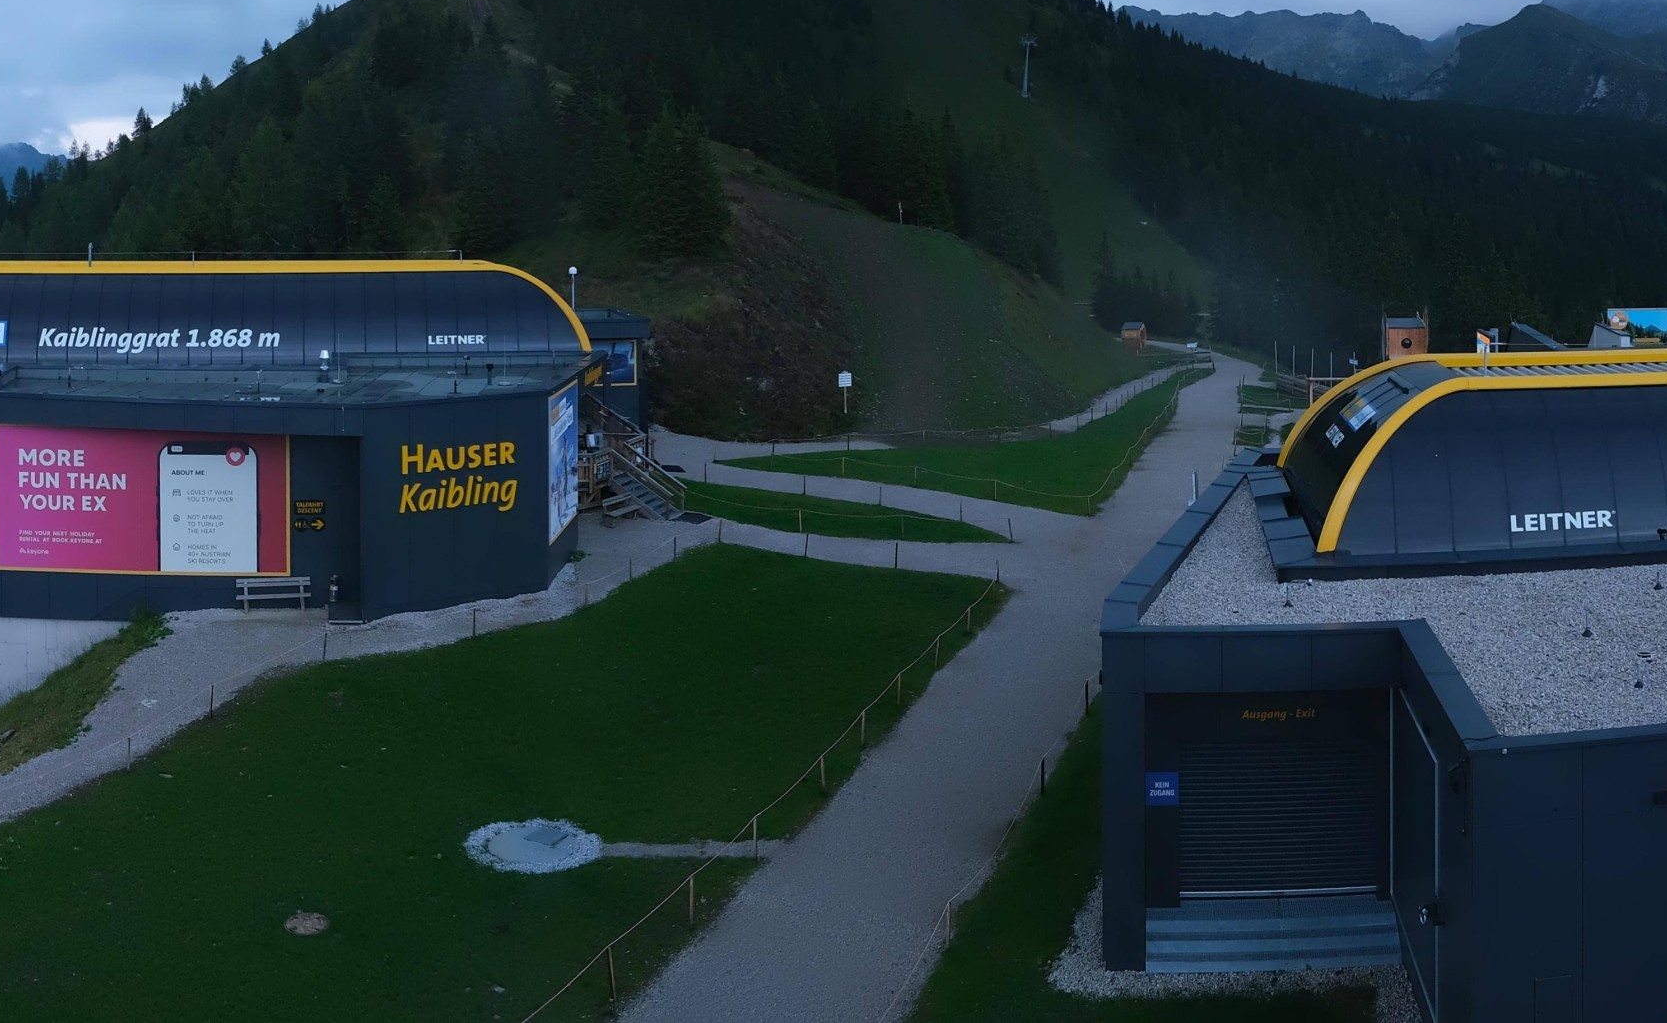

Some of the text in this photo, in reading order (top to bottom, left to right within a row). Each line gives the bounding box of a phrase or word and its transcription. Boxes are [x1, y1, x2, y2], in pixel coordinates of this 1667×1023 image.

[38, 327, 280, 354] Kaiblinggrat 1.868 m
[427, 334, 485, 345] LEITNER
[18, 448, 85, 467] MORE
[401, 441, 516, 475] HAUSER
[18, 471, 127, 490] FUN THAN
[19, 494, 107, 512] YOUR EX
[399, 475, 518, 514] Kaibling
[1510, 510, 1614, 532] LEITNER
[1241, 709, 1287, 722] Ausgang
[1295, 708, 1316, 718] Exit
[1149, 789, 1175, 797] ZUGANG
[1154, 781, 1170, 789] KEIN
